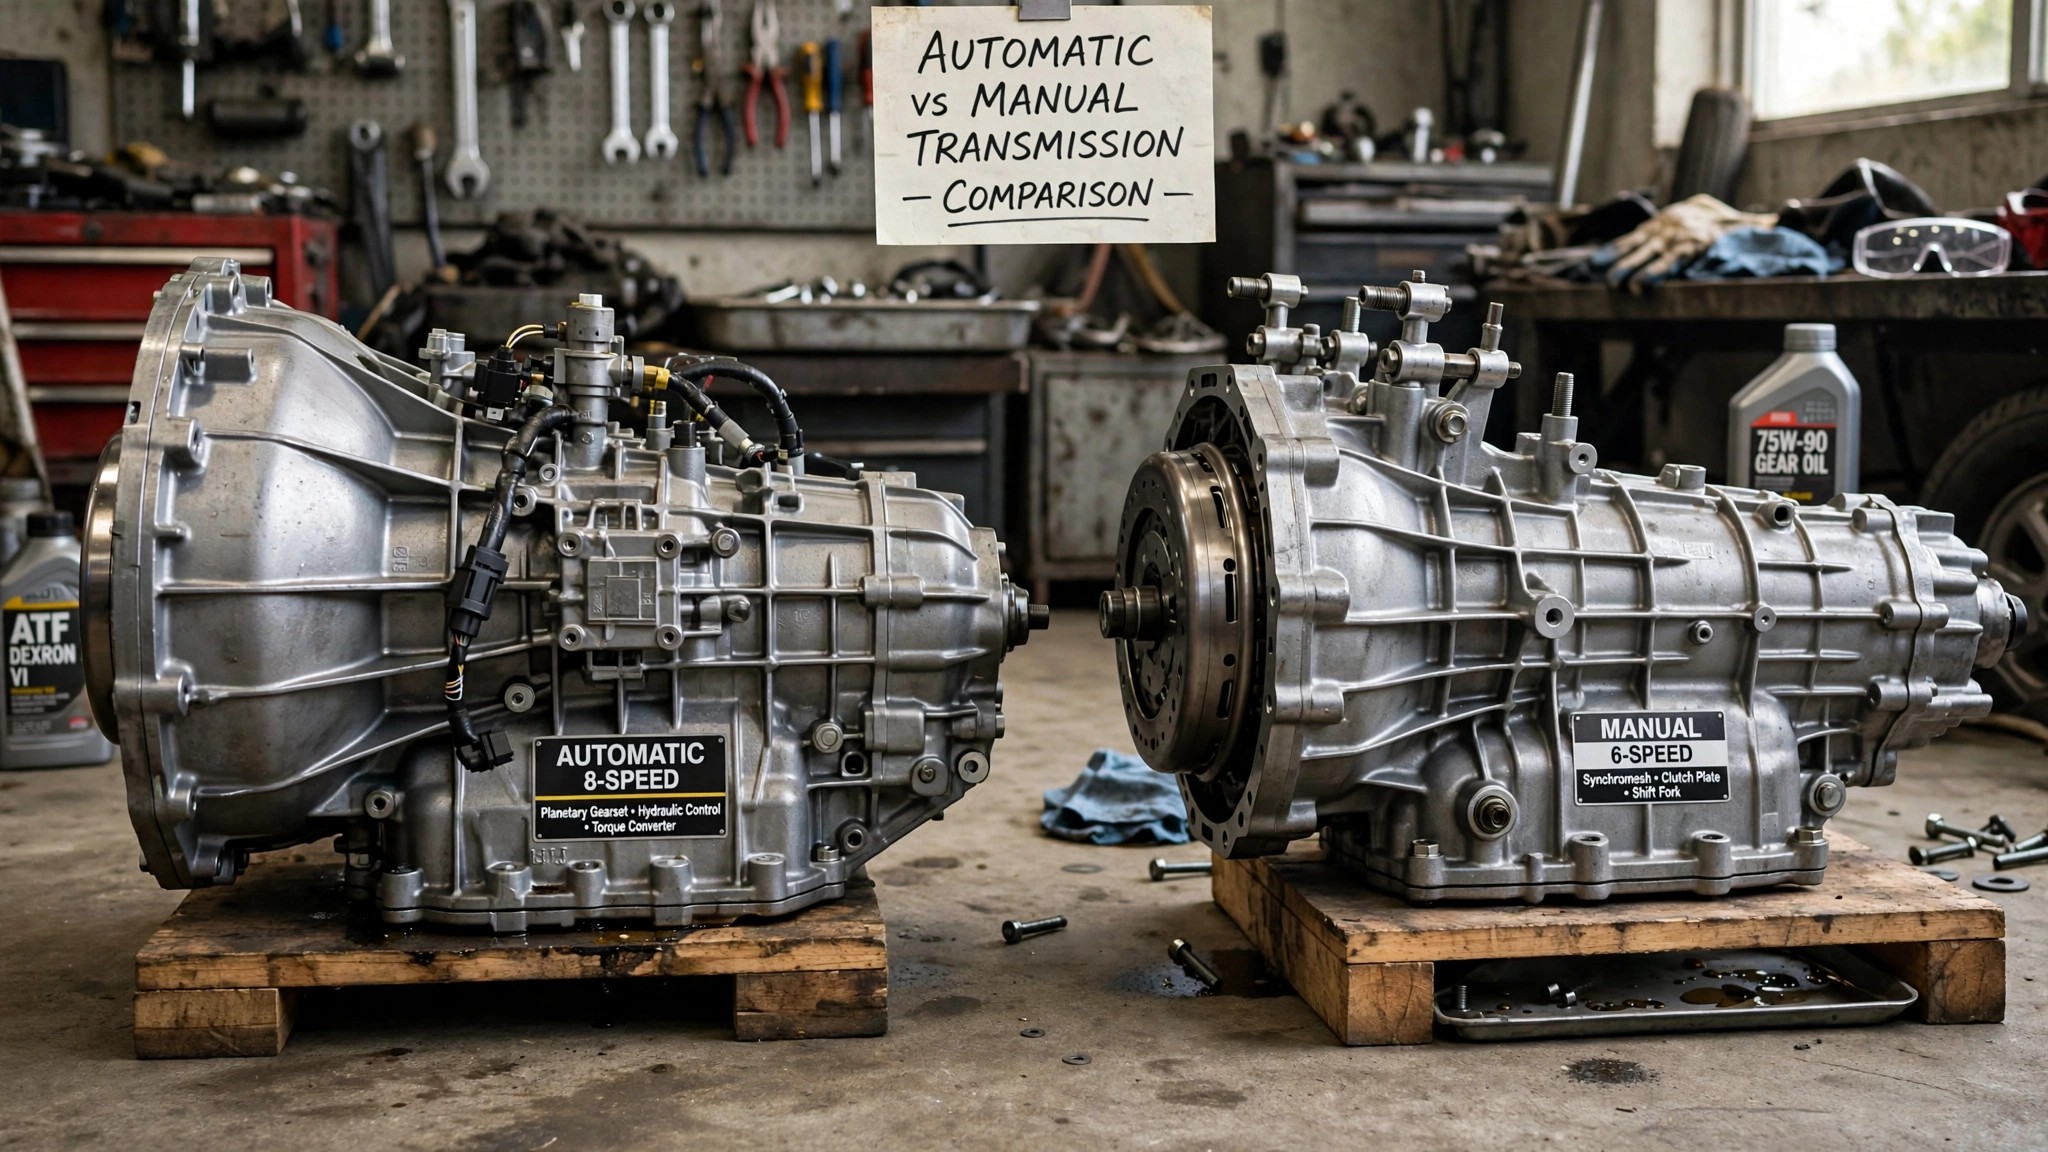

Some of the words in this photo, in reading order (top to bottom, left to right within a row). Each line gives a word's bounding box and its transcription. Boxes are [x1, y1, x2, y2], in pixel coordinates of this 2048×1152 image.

[918, 30, 1154, 74] AUTOMATIC
[971, 82, 1138, 117] MANUAL
[907, 126, 1184, 166] TRANSMISSION
[943, 178, 1153, 213] COMPARISON
[1756, 429, 1828, 453] 75W-90
[1755, 453, 1798, 474] GEAR
[1802, 453, 1828, 474] OIL
[10, 612, 70, 644] ATF
[9, 644, 76, 665] DEXRON
[10, 667, 28, 686] VI
[1600, 717, 1702, 739] MANUAL
[556, 742, 705, 767] AUTOMATIC
[1611, 744, 1693, 764] 6-SPEED
[583, 769, 679, 791] 8-SPEED
[1582, 772, 1651, 787] Synchromesh
[1661, 771, 1694, 783] Clutch
[1696, 770, 1721, 783] Plate
[1632, 786, 1656, 799] Shift
[1658, 785, 1681, 798] Fork
[540, 806, 587, 821] Planetary
[590, 805, 628, 818] Gearset
[638, 804, 684, 820] Hydraulic
[685, 803, 721, 816] Control
[591, 820, 626, 836] Torque
[628, 819, 676, 832] Converter
